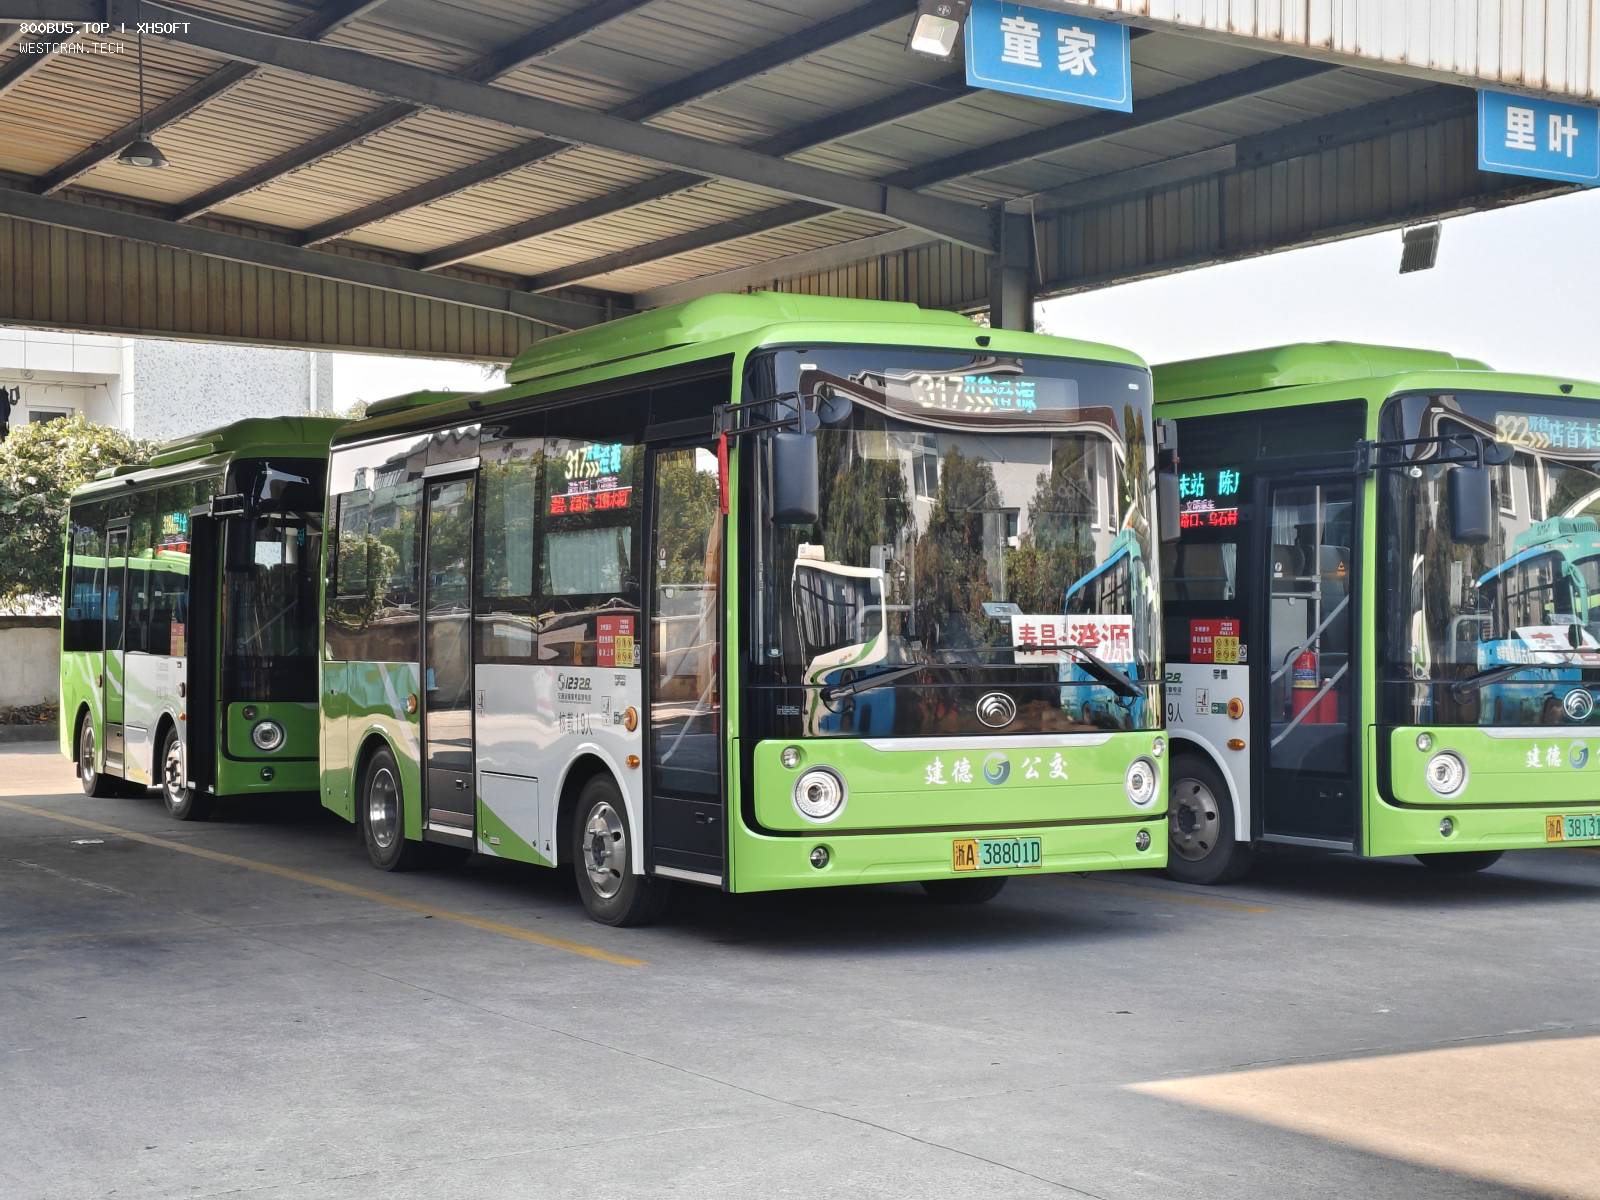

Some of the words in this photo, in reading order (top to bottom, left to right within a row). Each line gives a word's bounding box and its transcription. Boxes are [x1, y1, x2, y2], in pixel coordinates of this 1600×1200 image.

[999, 16, 1097, 75] 童家
[1505, 106, 1578, 158] 里叶
[917, 374, 963, 408] 317
[1495, 414, 1529, 444] 322
[564, 446, 588, 480] 317
[925, 756, 974, 785] 建德
[1021, 752, 1069, 780] 公交
[983, 841, 1040, 865] 38801D
